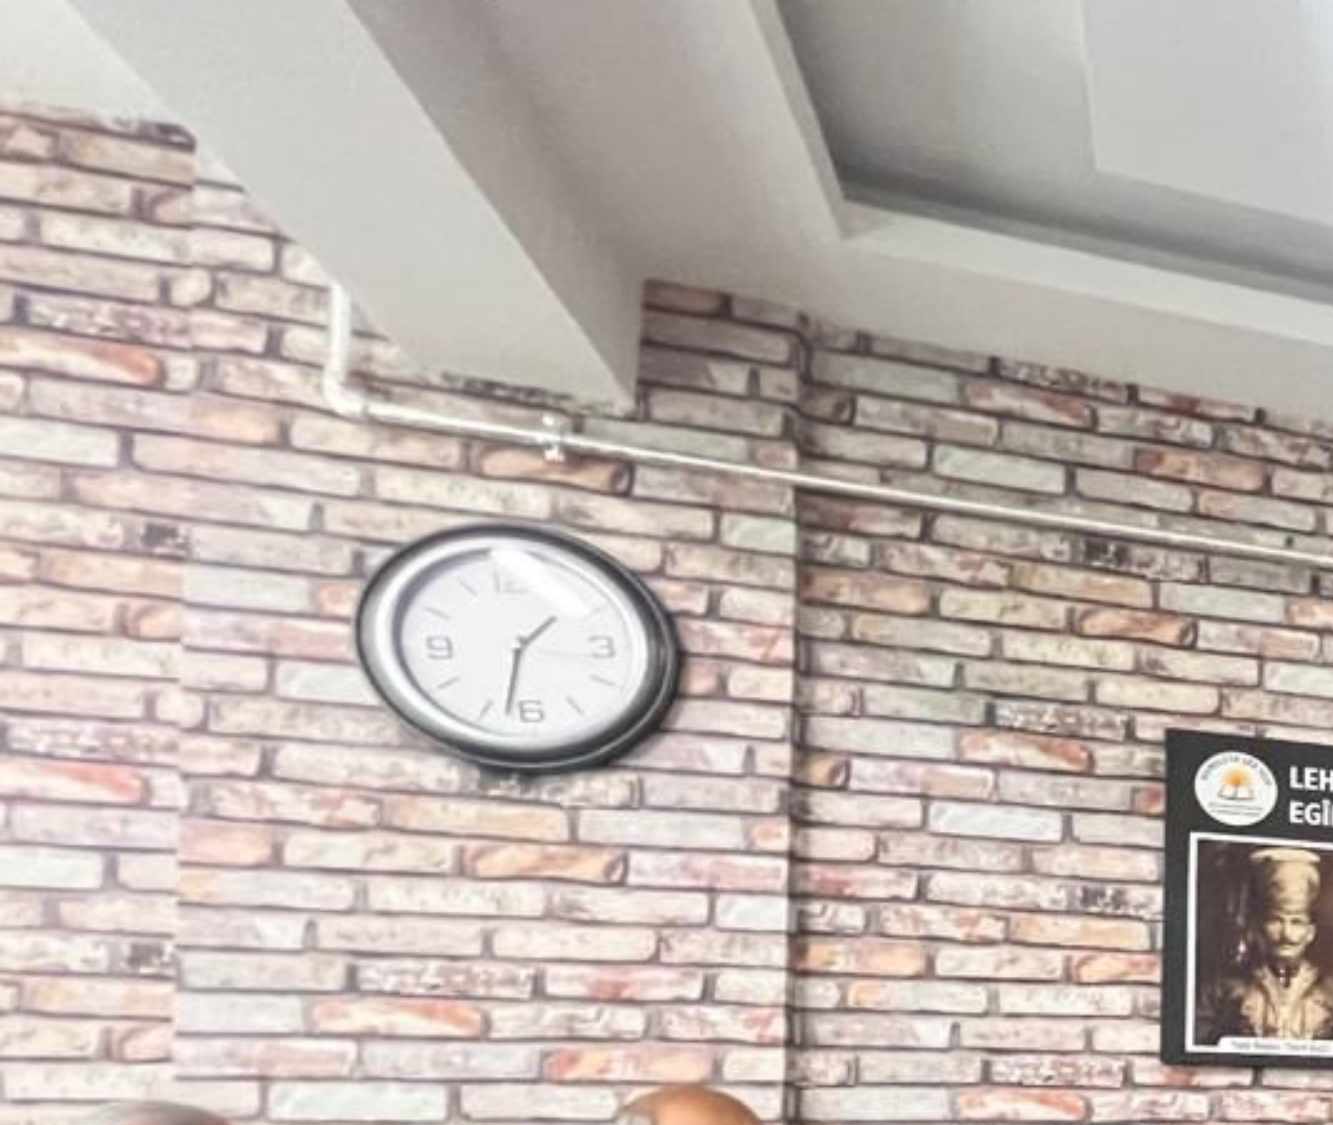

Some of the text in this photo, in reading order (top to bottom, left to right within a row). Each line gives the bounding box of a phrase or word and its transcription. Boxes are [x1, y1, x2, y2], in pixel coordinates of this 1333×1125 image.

[425, 634, 453, 660] 9
[588, 634, 615, 660] 3
[518, 699, 544, 723] 6
